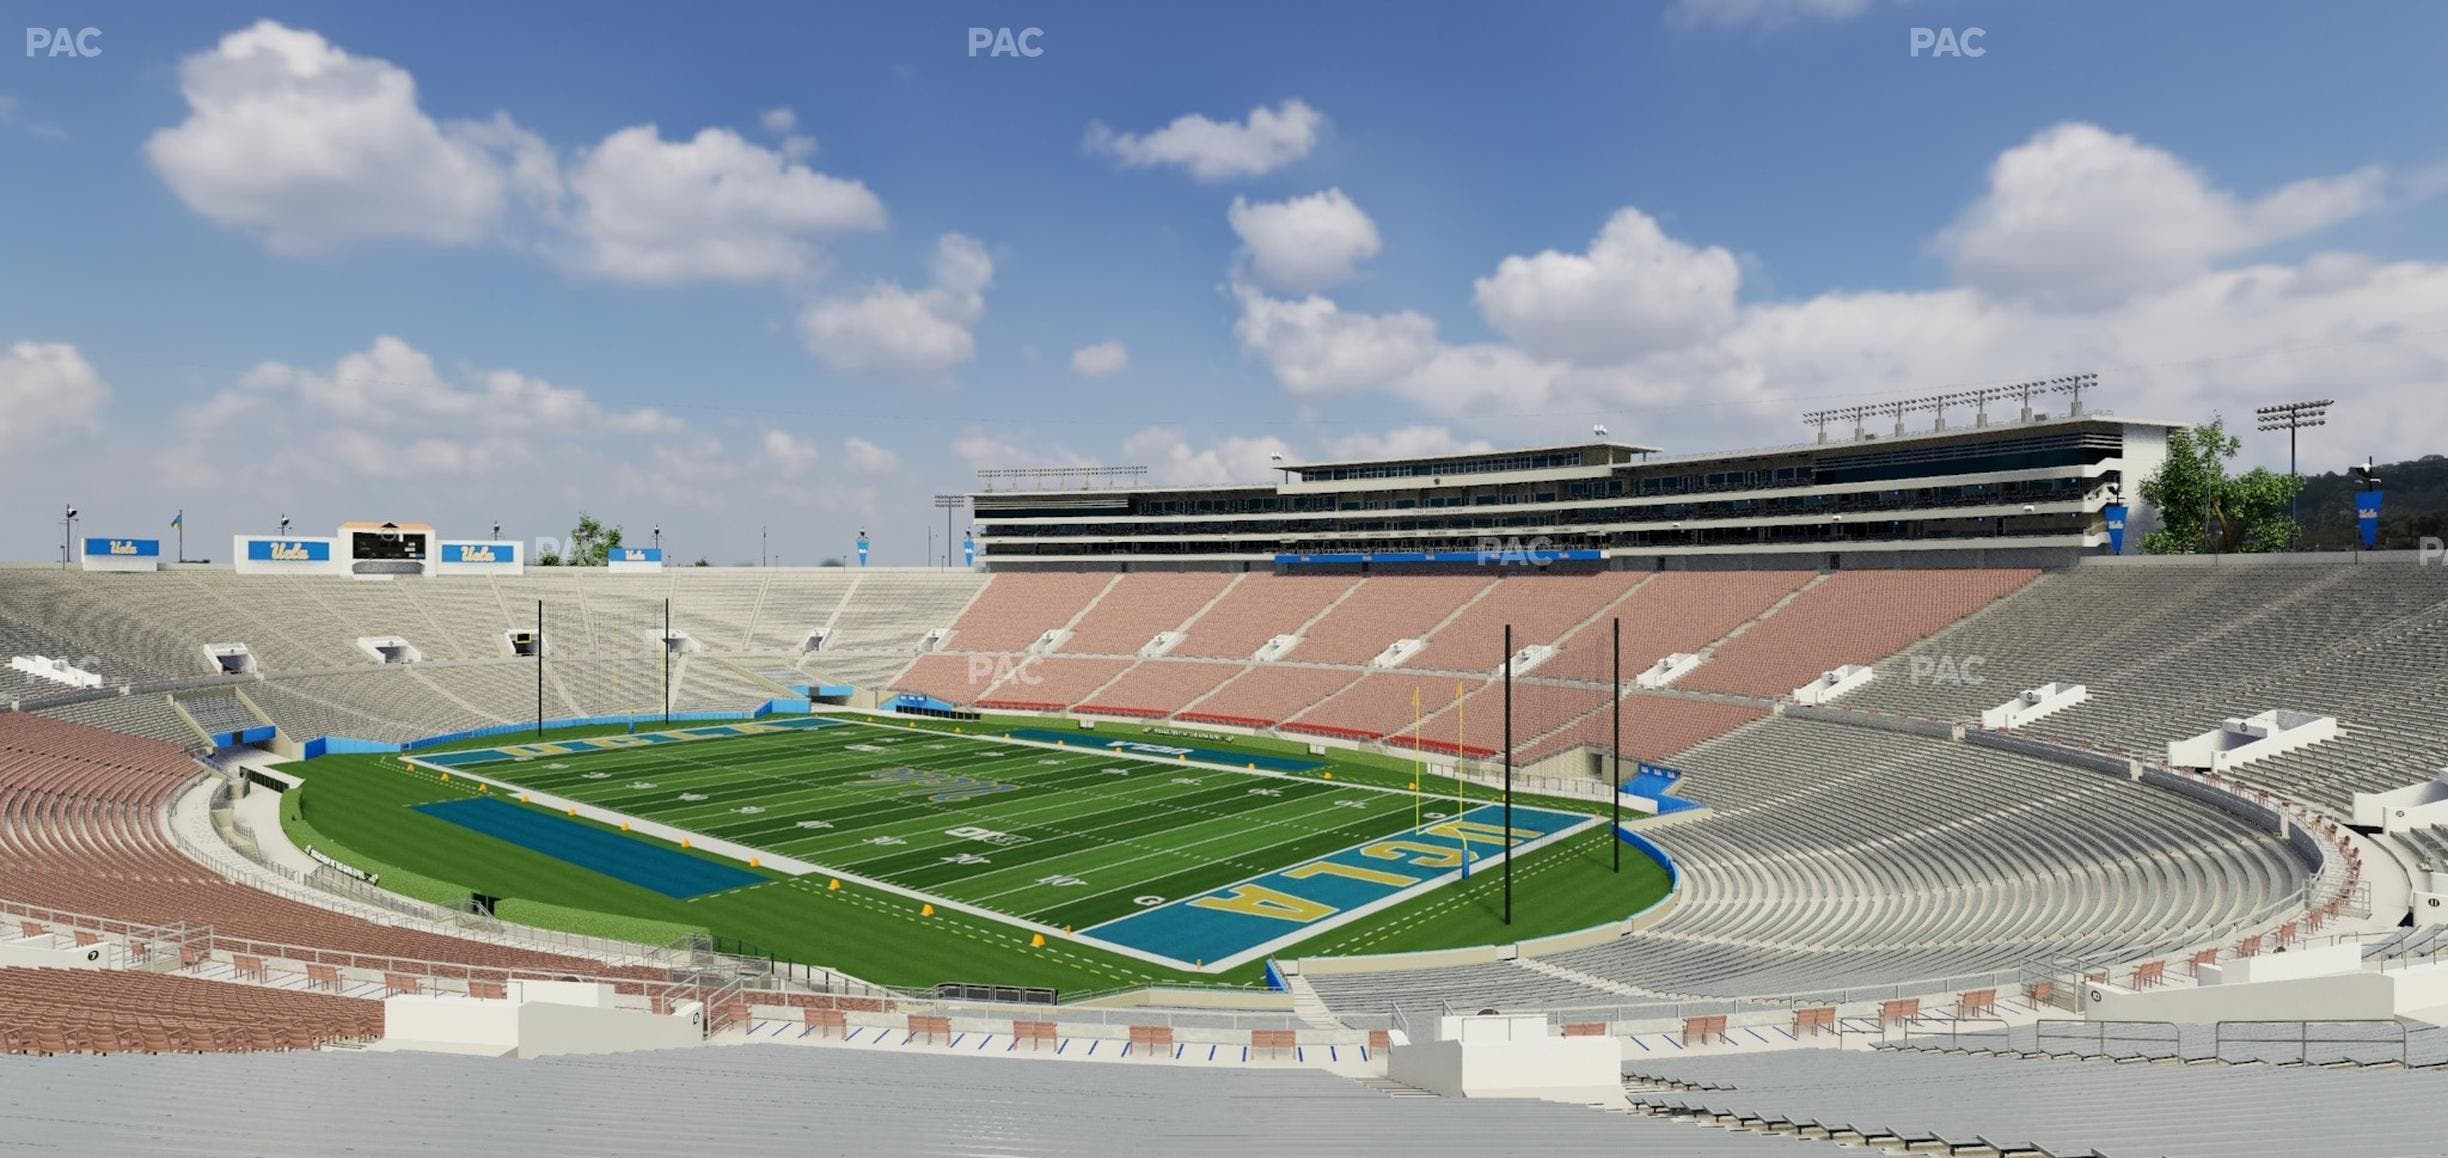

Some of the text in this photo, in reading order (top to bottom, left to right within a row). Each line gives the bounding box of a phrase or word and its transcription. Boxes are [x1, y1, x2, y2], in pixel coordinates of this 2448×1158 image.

[1191, 820, 1545, 923] UCLA
[1035, 874, 1082, 887] 10
[1133, 895, 1166, 906] G
